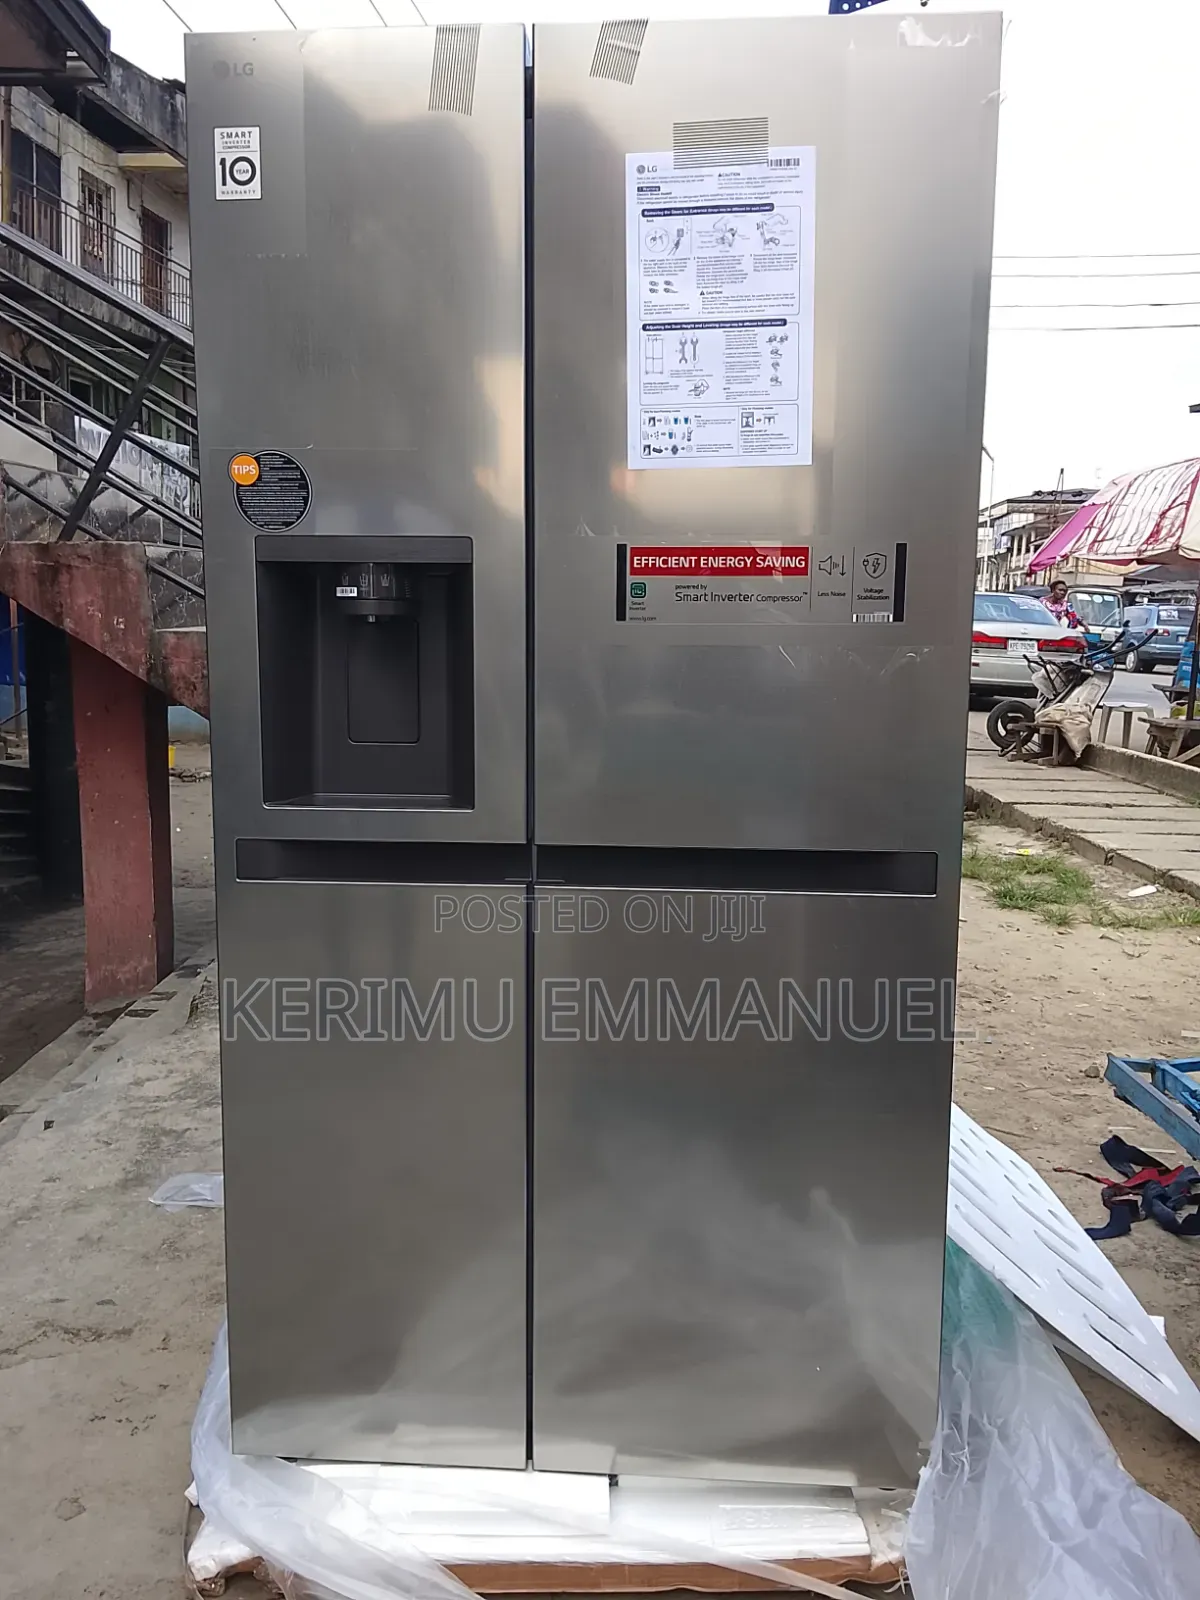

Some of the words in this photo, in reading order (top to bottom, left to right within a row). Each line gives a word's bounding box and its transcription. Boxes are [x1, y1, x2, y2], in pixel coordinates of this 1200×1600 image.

[233, 62, 254, 77] LG
[219, 131, 253, 140] SMART
[219, 156, 257, 186] 10
[647, 165, 658, 173] LG
[233, 465, 256, 475] TIPS
[633, 556, 698, 568] EFFICIENT
[700, 556, 753, 568] ENERGY
[756, 556, 806, 568] SAVING
[675, 591, 708, 602] Smart
[711, 591, 754, 602] Inverter
